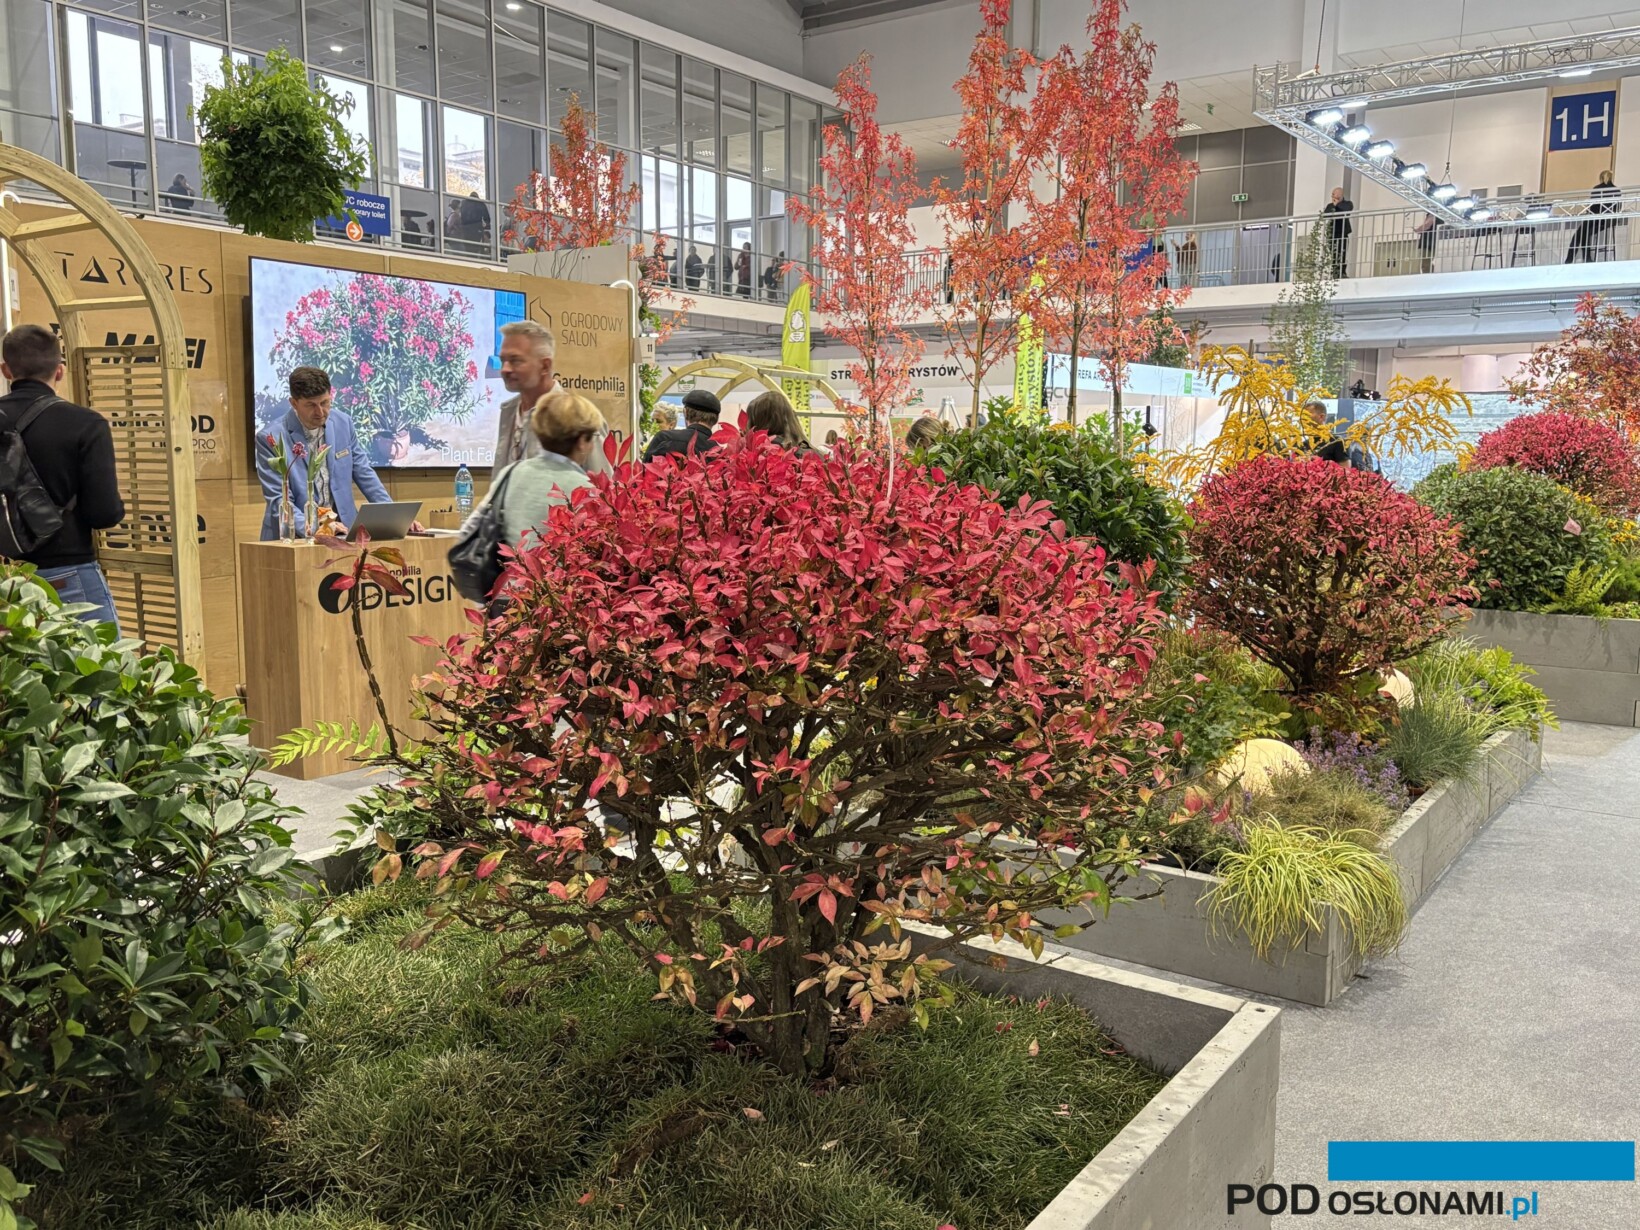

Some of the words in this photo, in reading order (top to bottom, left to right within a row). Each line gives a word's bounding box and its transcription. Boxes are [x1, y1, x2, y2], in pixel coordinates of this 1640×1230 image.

[1556, 101, 1609, 142] 1.H
[357, 199, 385, 210] robocze
[372, 211, 386, 219] toilet
[561, 311, 624, 333] OGRODOWY
[561, 329, 598, 348] SALON
[441, 447, 474, 462] Plant
